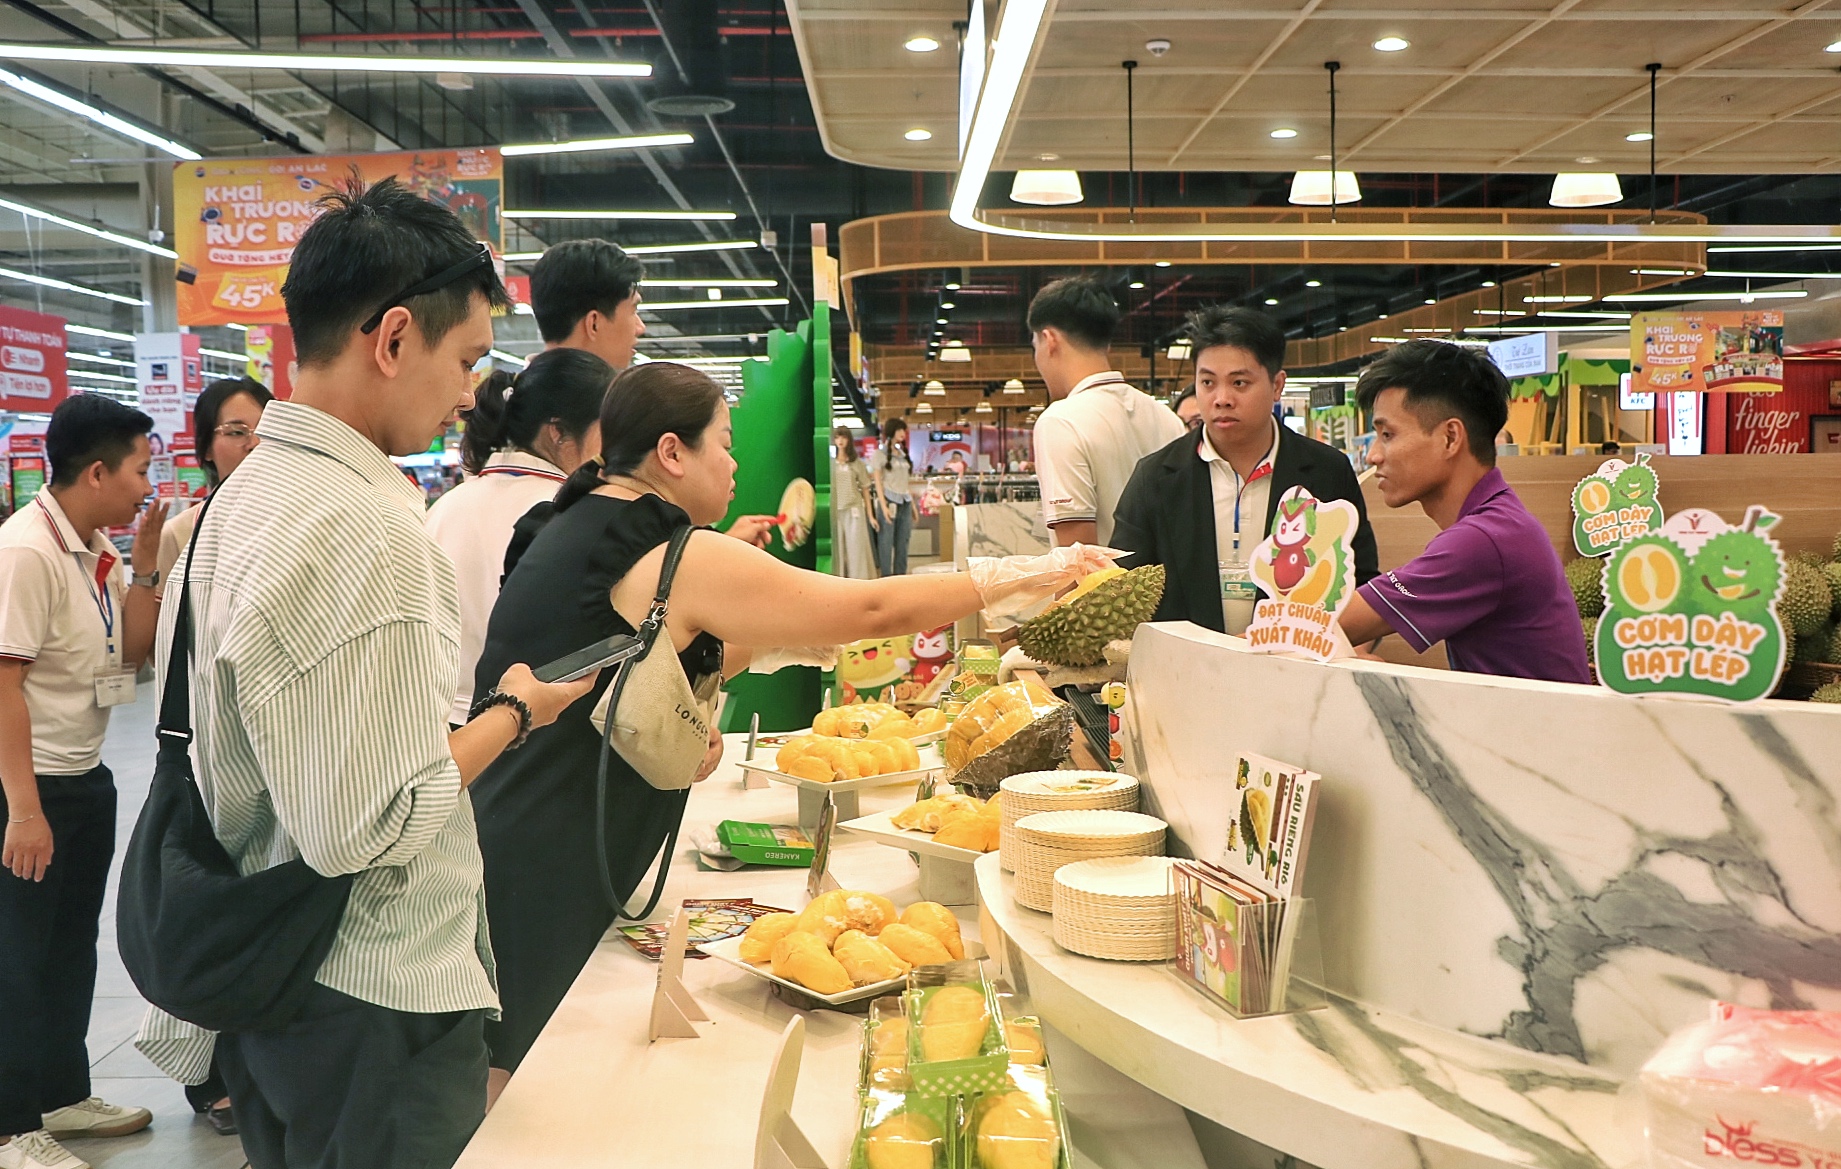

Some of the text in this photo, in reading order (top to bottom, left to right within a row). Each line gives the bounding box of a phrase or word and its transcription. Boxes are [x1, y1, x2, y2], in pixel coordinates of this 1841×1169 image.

[1735, 398, 1800, 439] finger
[1584, 505, 1652, 531] CƠM DÀY
[1590, 527, 1619, 546] HẠT
[1258, 602, 1332, 627] ĐẠT CHUẨN
[1250, 618, 1334, 657] XUẤT KHẨU
[1618, 614, 1763, 650] CƠM DÀY
[1626, 649, 1746, 681] HẠT LÉP
[764, 851, 800, 860] KAMEREO
